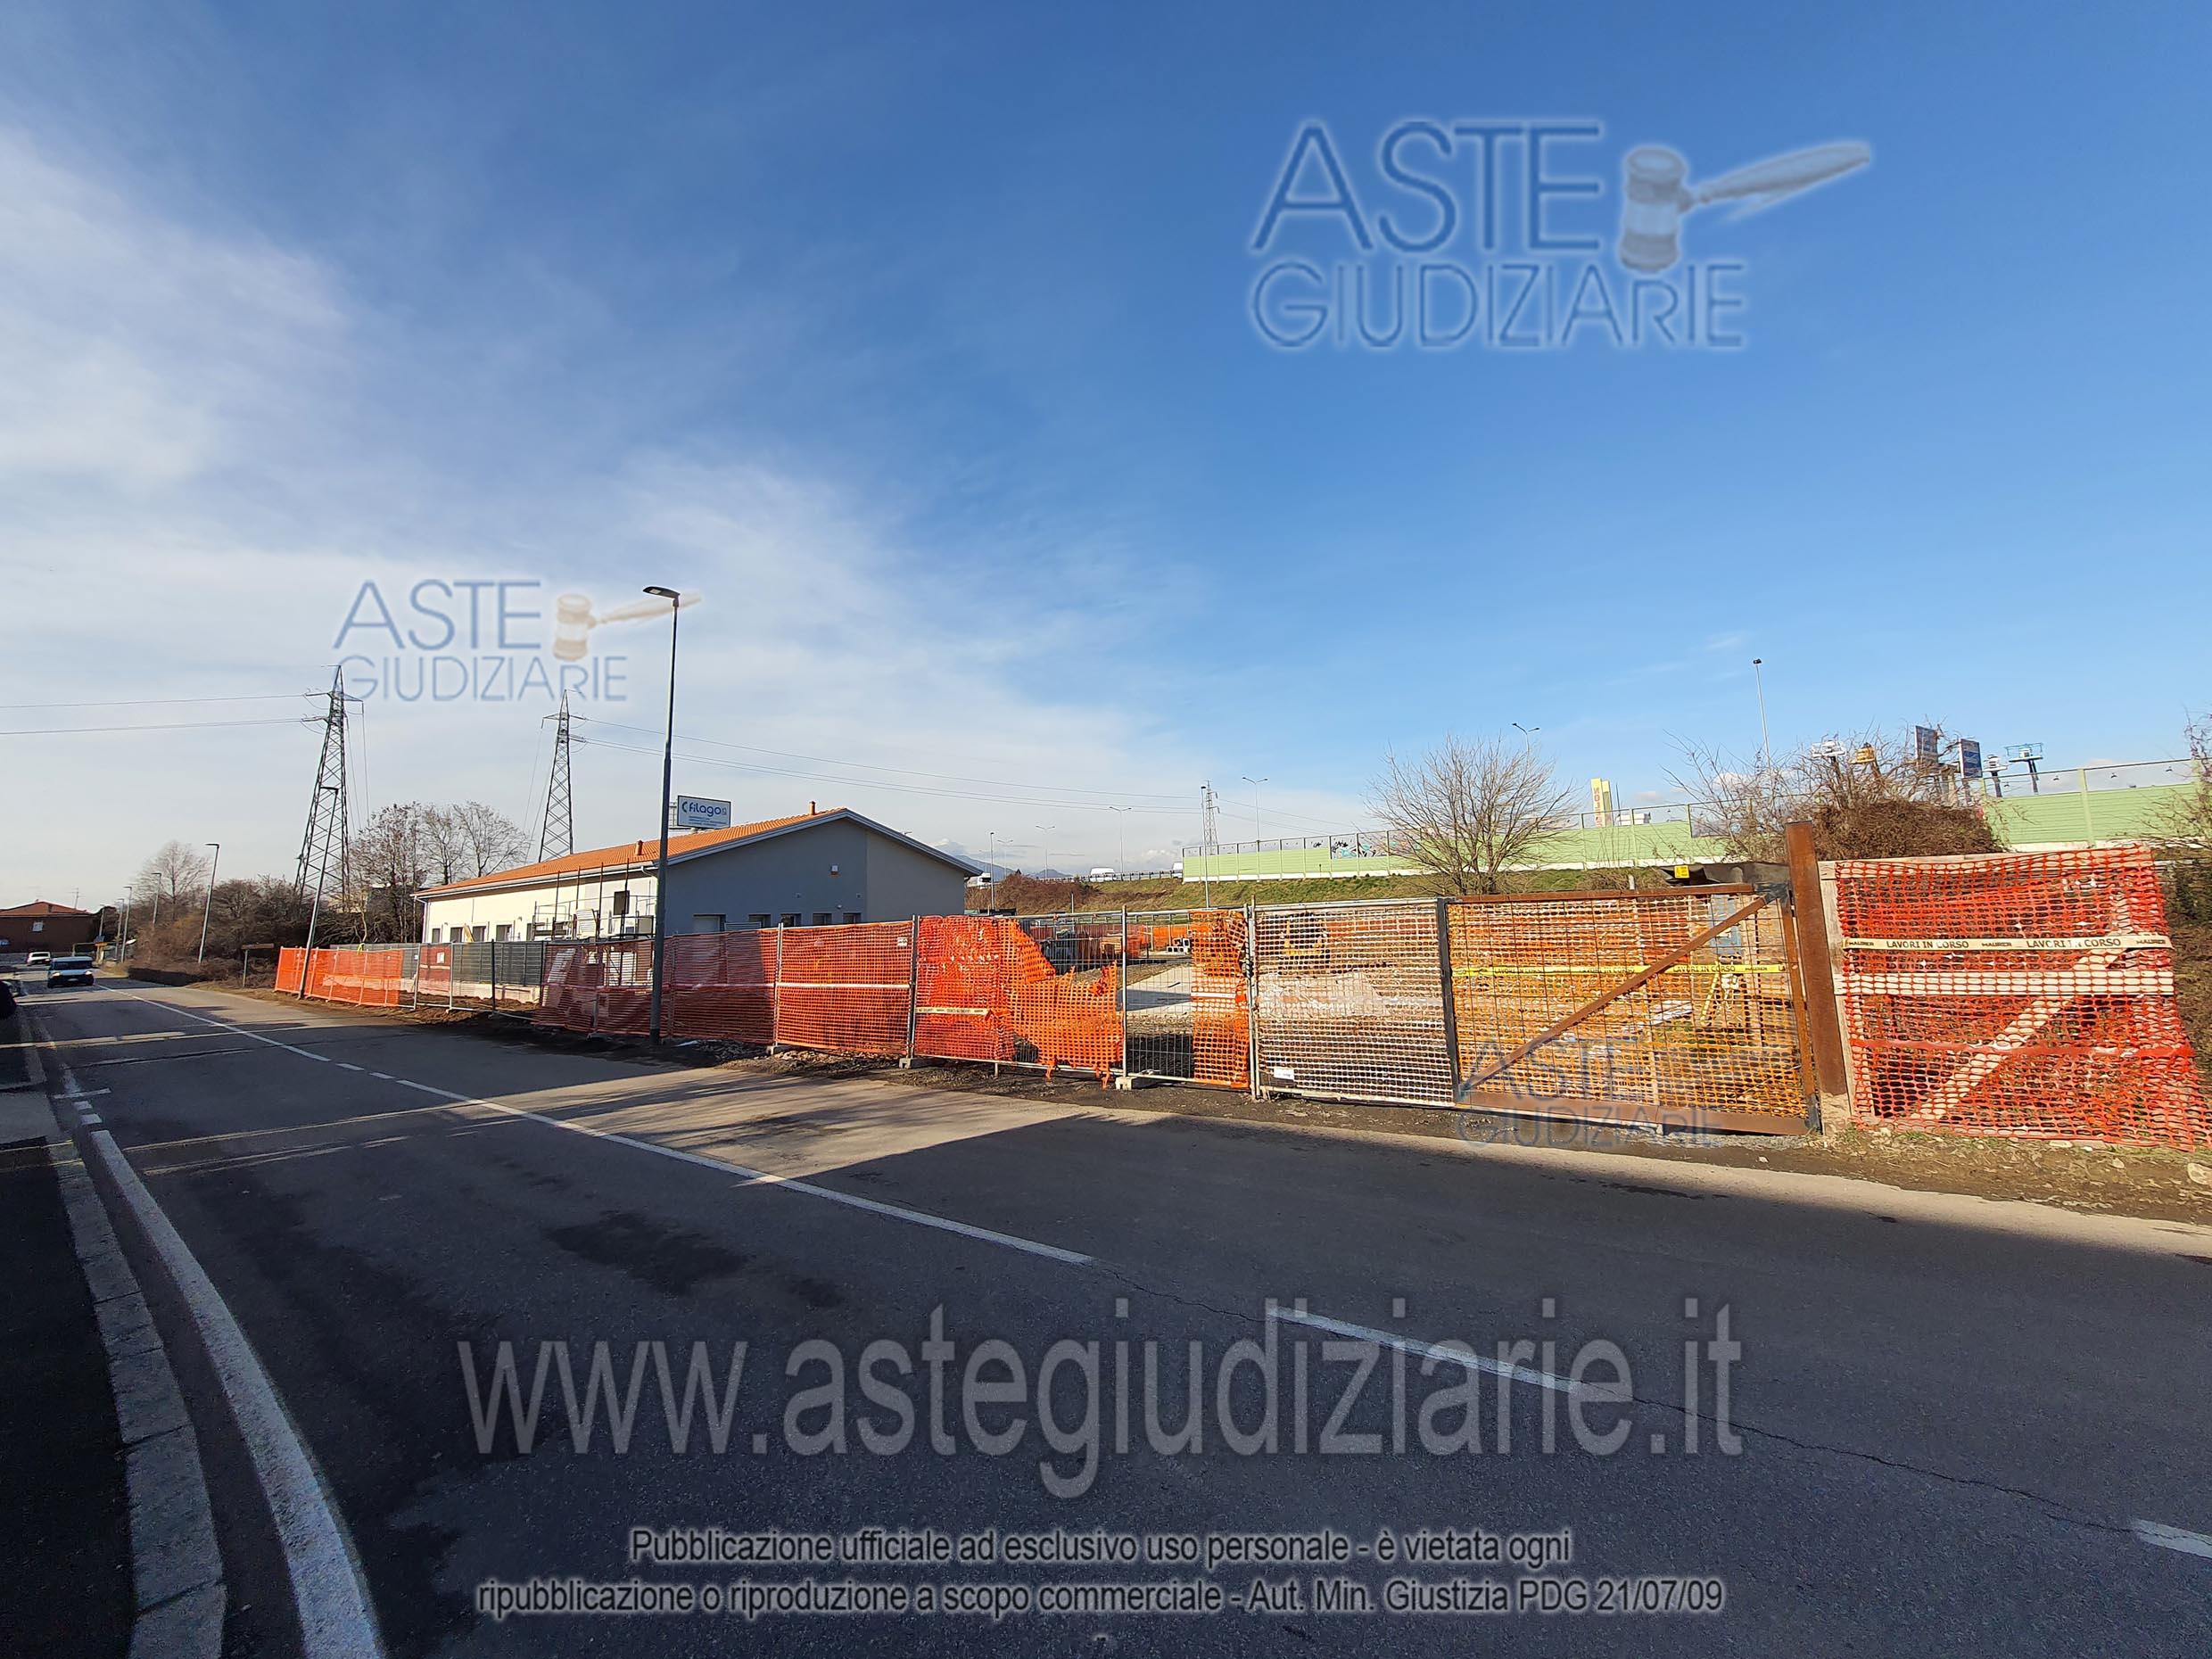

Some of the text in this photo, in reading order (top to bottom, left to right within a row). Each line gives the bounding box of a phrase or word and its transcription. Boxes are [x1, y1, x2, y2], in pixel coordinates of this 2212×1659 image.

[1886, 940, 1919, 949] LAVORI
[1923, 941, 1933, 949] IN
[2084, 938, 2121, 947] CORSO
